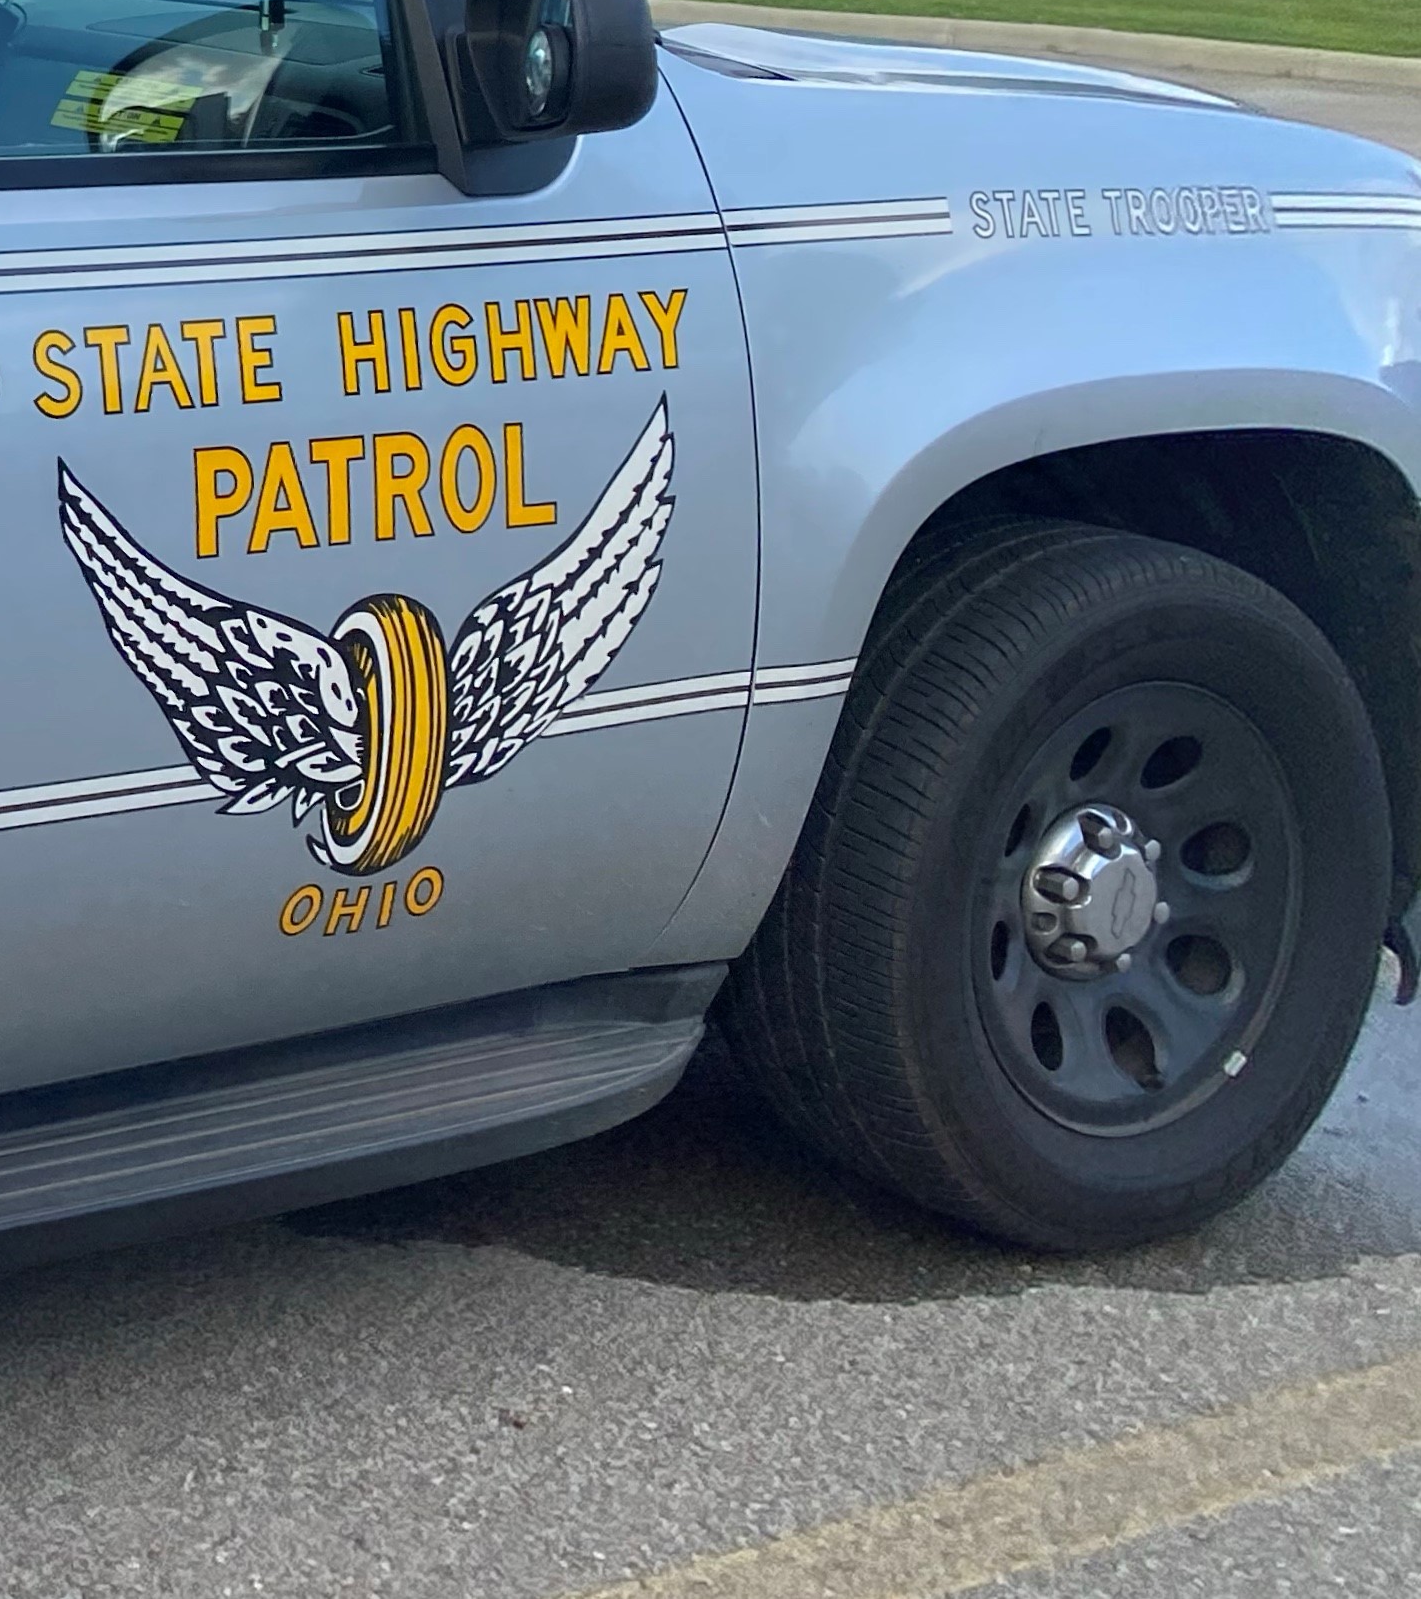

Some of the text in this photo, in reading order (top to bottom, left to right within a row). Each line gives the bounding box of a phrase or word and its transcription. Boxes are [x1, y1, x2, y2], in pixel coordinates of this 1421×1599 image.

[970, 184, 1272, 239] STATE TROOPER
[33, 288, 689, 419] STATE HIGHWAY
[192, 422, 558, 559] PATROL
[278, 866, 445, 936] OHIO
